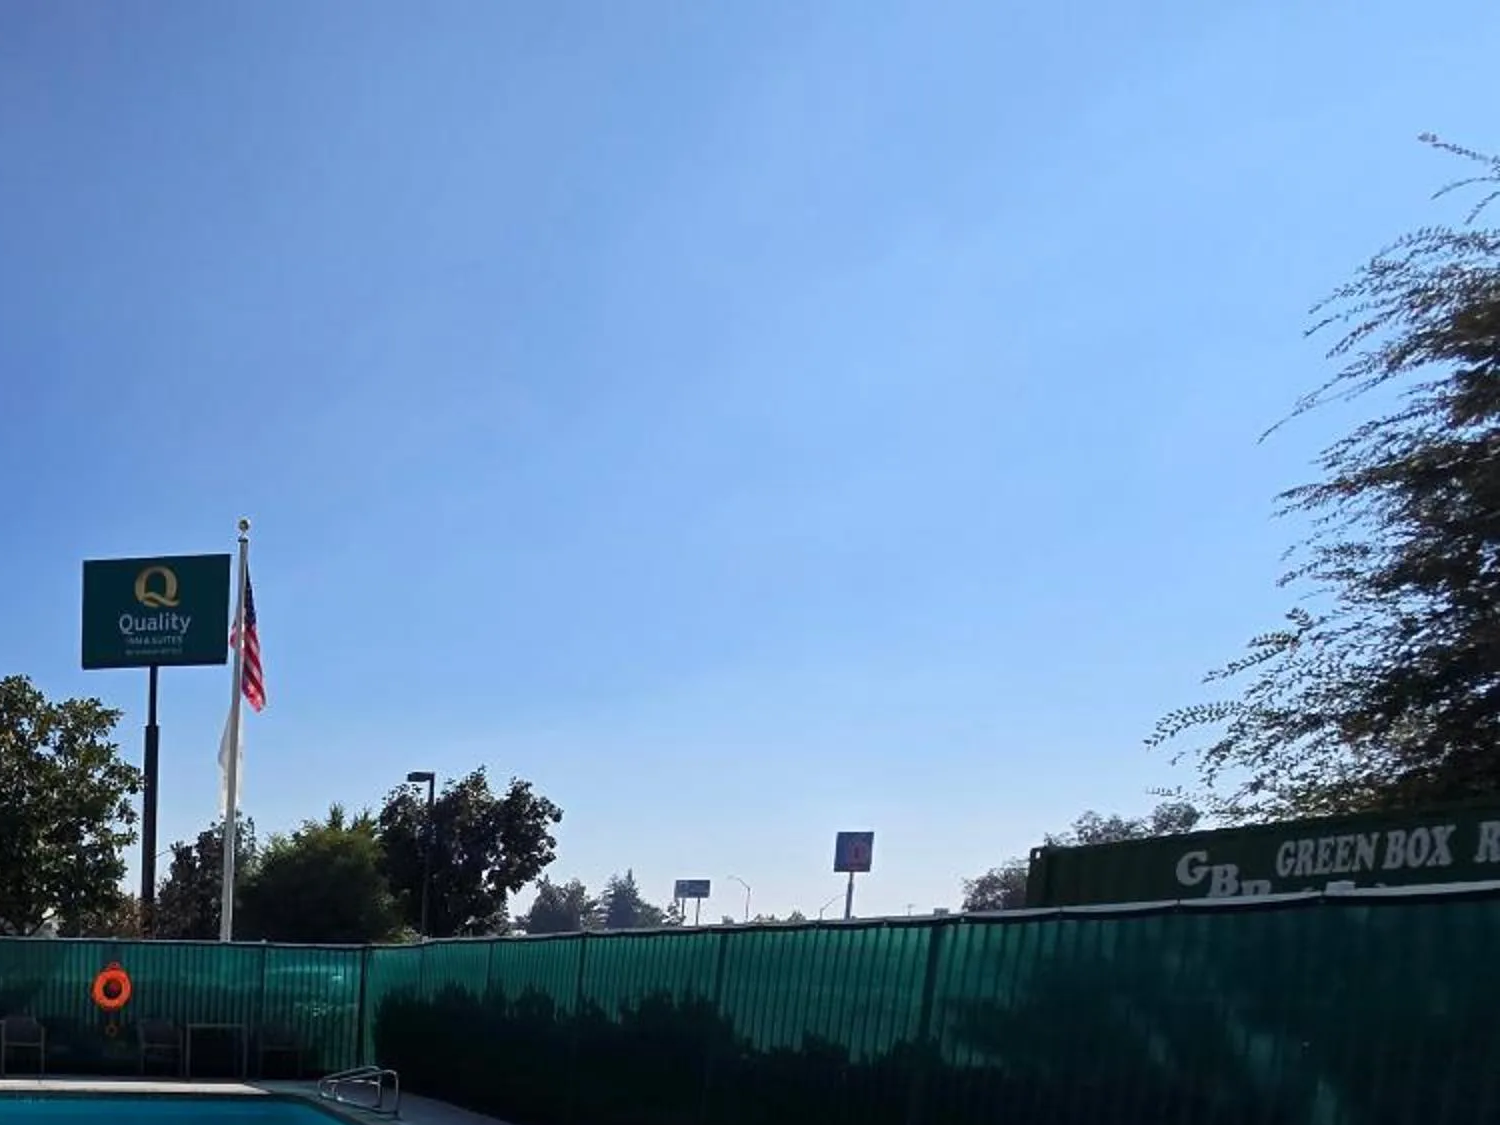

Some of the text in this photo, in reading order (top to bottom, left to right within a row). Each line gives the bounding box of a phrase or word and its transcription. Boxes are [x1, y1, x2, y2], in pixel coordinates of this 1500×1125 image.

[135, 567, 180, 607] Q
[119, 612, 191, 635] Quality
[1276, 833, 1379, 877] GREEN
[1382, 825, 1457, 870] BOX
